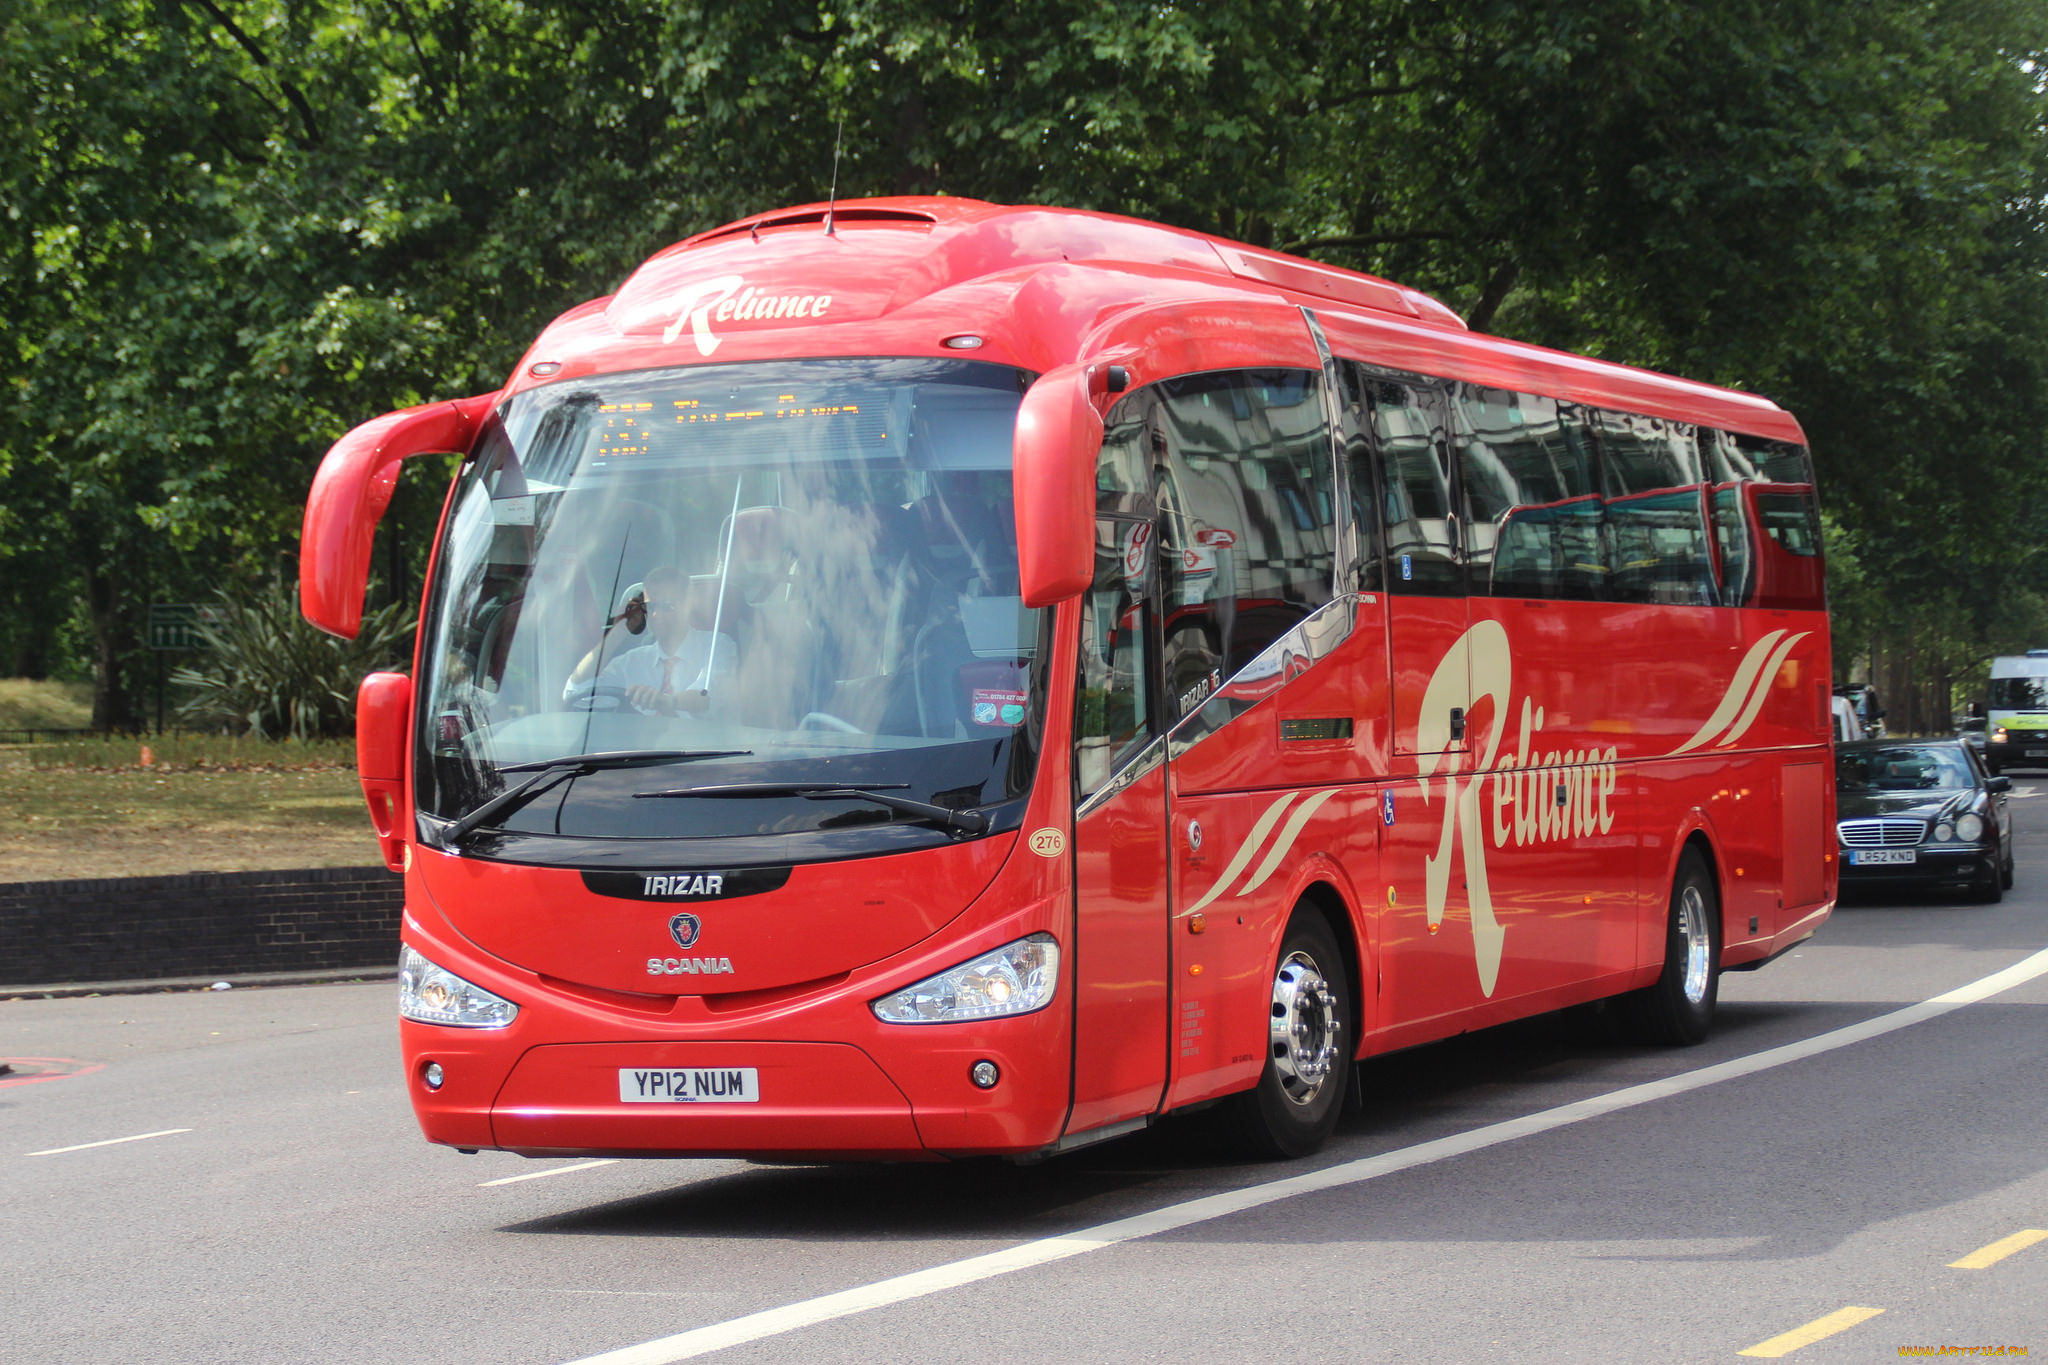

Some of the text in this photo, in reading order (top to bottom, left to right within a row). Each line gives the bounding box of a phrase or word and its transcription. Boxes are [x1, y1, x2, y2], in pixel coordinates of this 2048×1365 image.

[663, 275, 832, 356] Reliance
[1180, 678, 1209, 716] IRIZAR
[1417, 620, 1618, 998] Reliance
[1035, 836, 1061, 849] 276
[1857, 851, 1888, 863] LR52
[643, 875, 723, 896] IRIZAR
[646, 957, 735, 976] SCANIA
[634, 1071, 743, 1097] YP12 NUM
